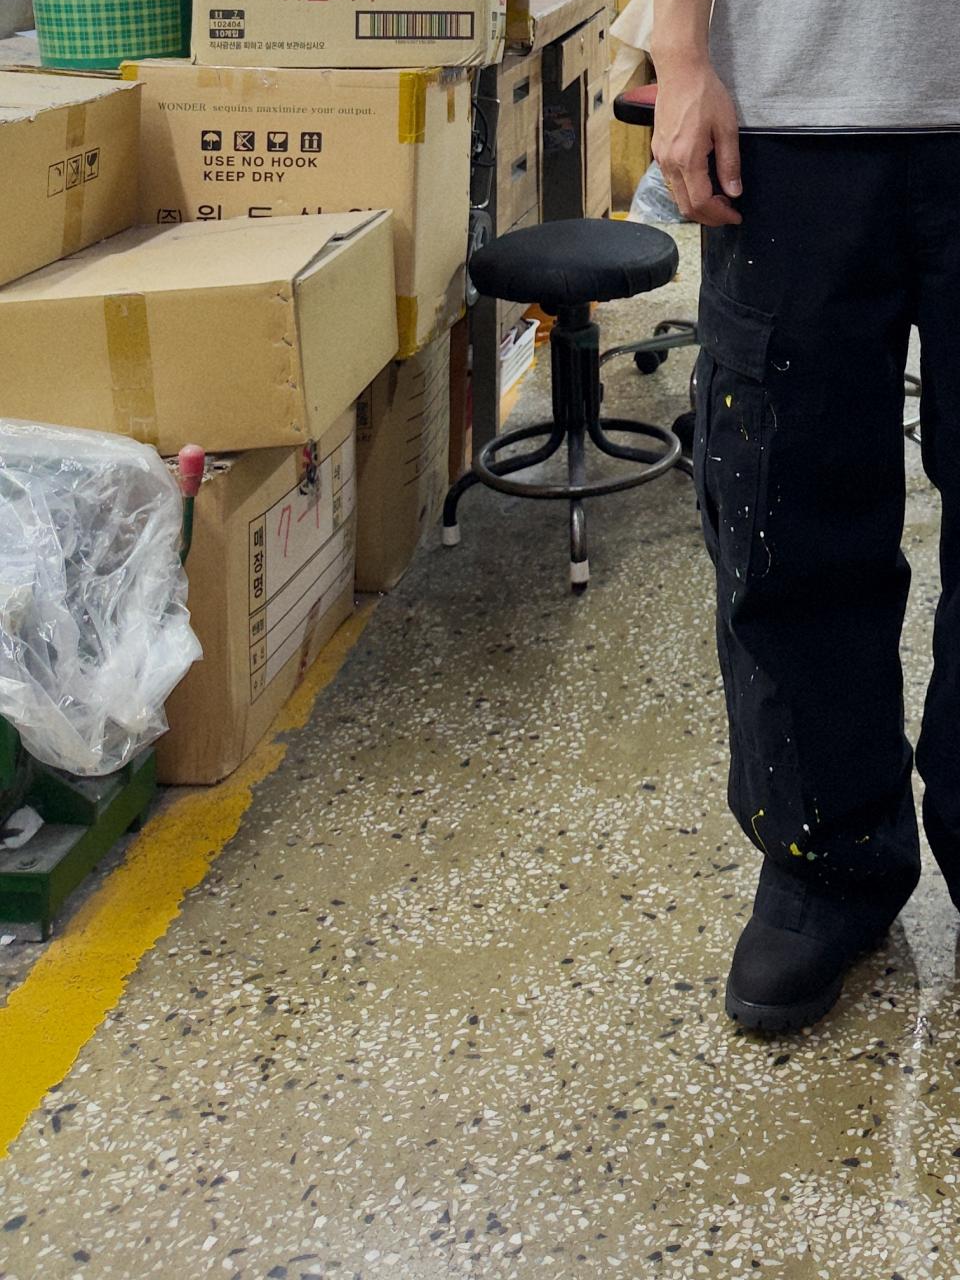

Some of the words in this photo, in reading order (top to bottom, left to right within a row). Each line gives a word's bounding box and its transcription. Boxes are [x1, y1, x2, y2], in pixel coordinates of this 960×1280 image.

[158, 102, 206, 112] WONDER
[203, 156, 235, 168] USE
[242, 156, 265, 168] NO
[271, 156, 318, 168] HOOK
[203, 171, 246, 182] KEEP
[252, 171, 286, 183] DRY
